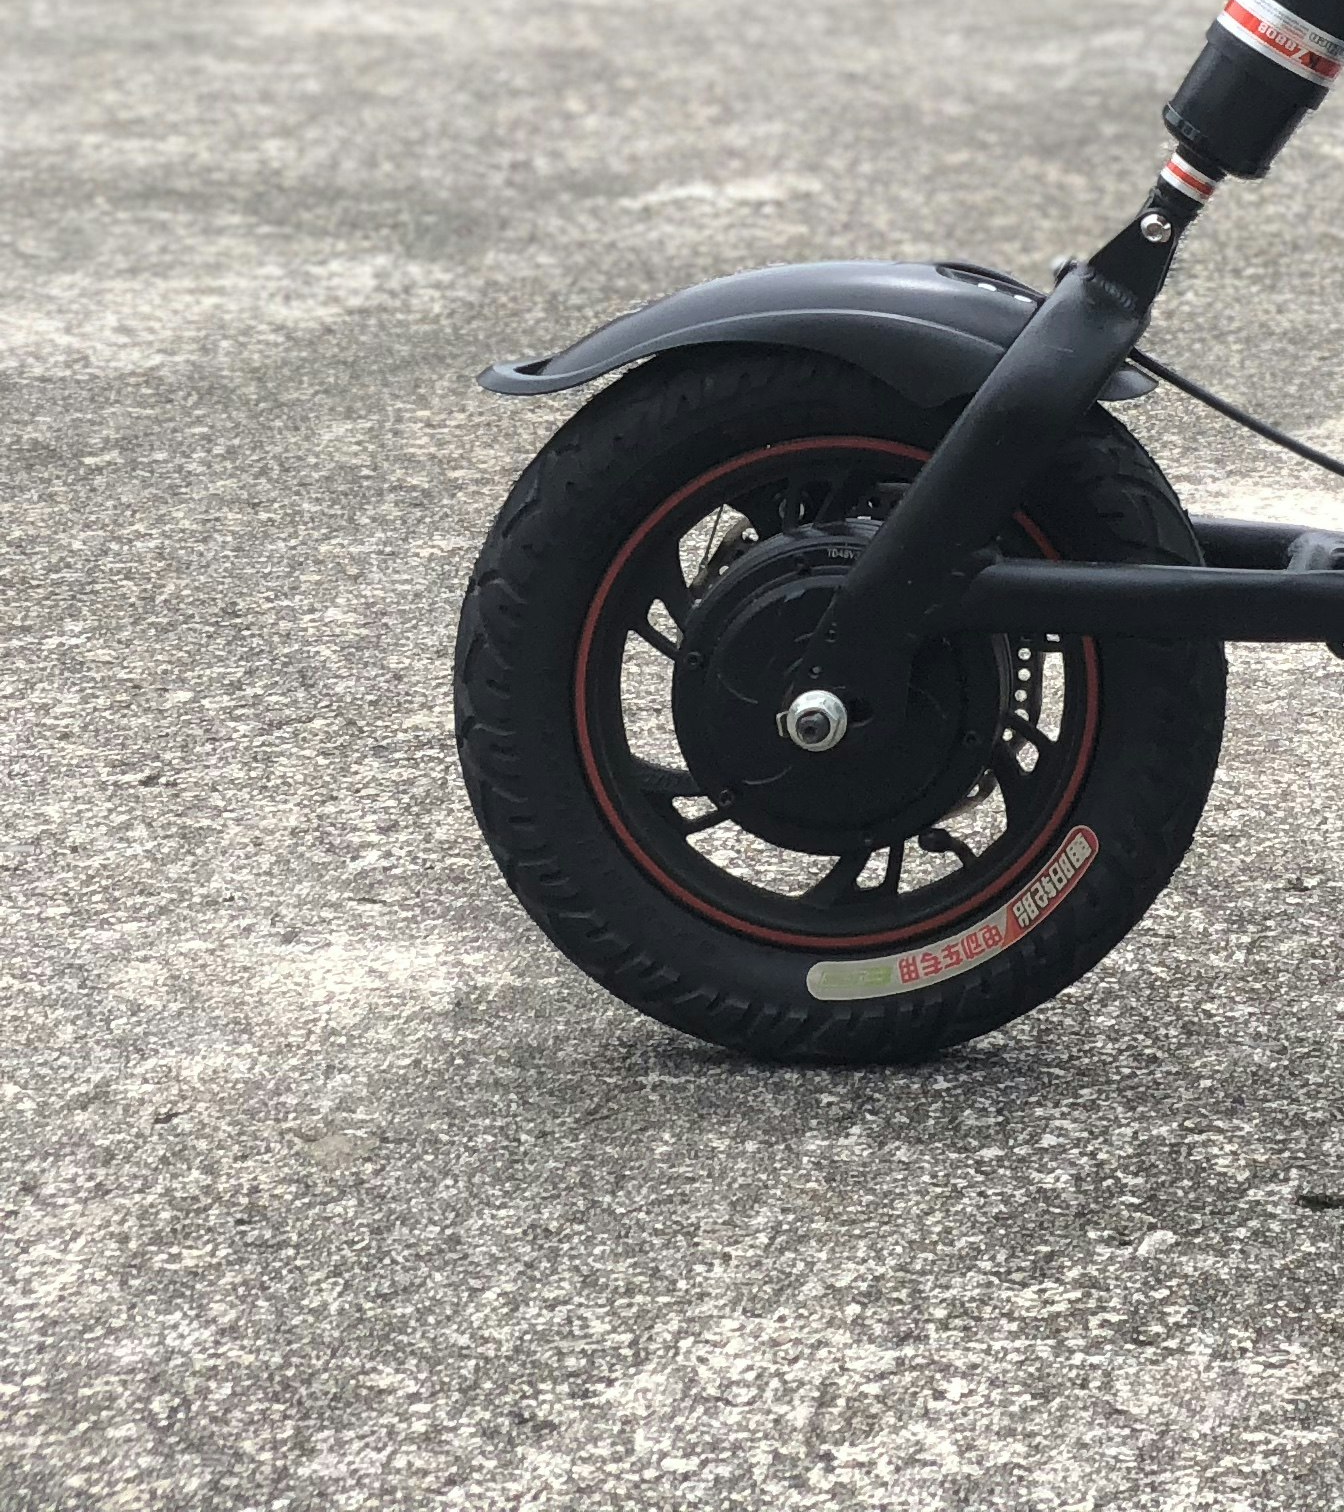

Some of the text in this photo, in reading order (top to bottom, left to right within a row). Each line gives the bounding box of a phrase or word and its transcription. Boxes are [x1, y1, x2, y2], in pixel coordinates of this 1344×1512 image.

[898, 923, 1003, 985] 电动车专用
